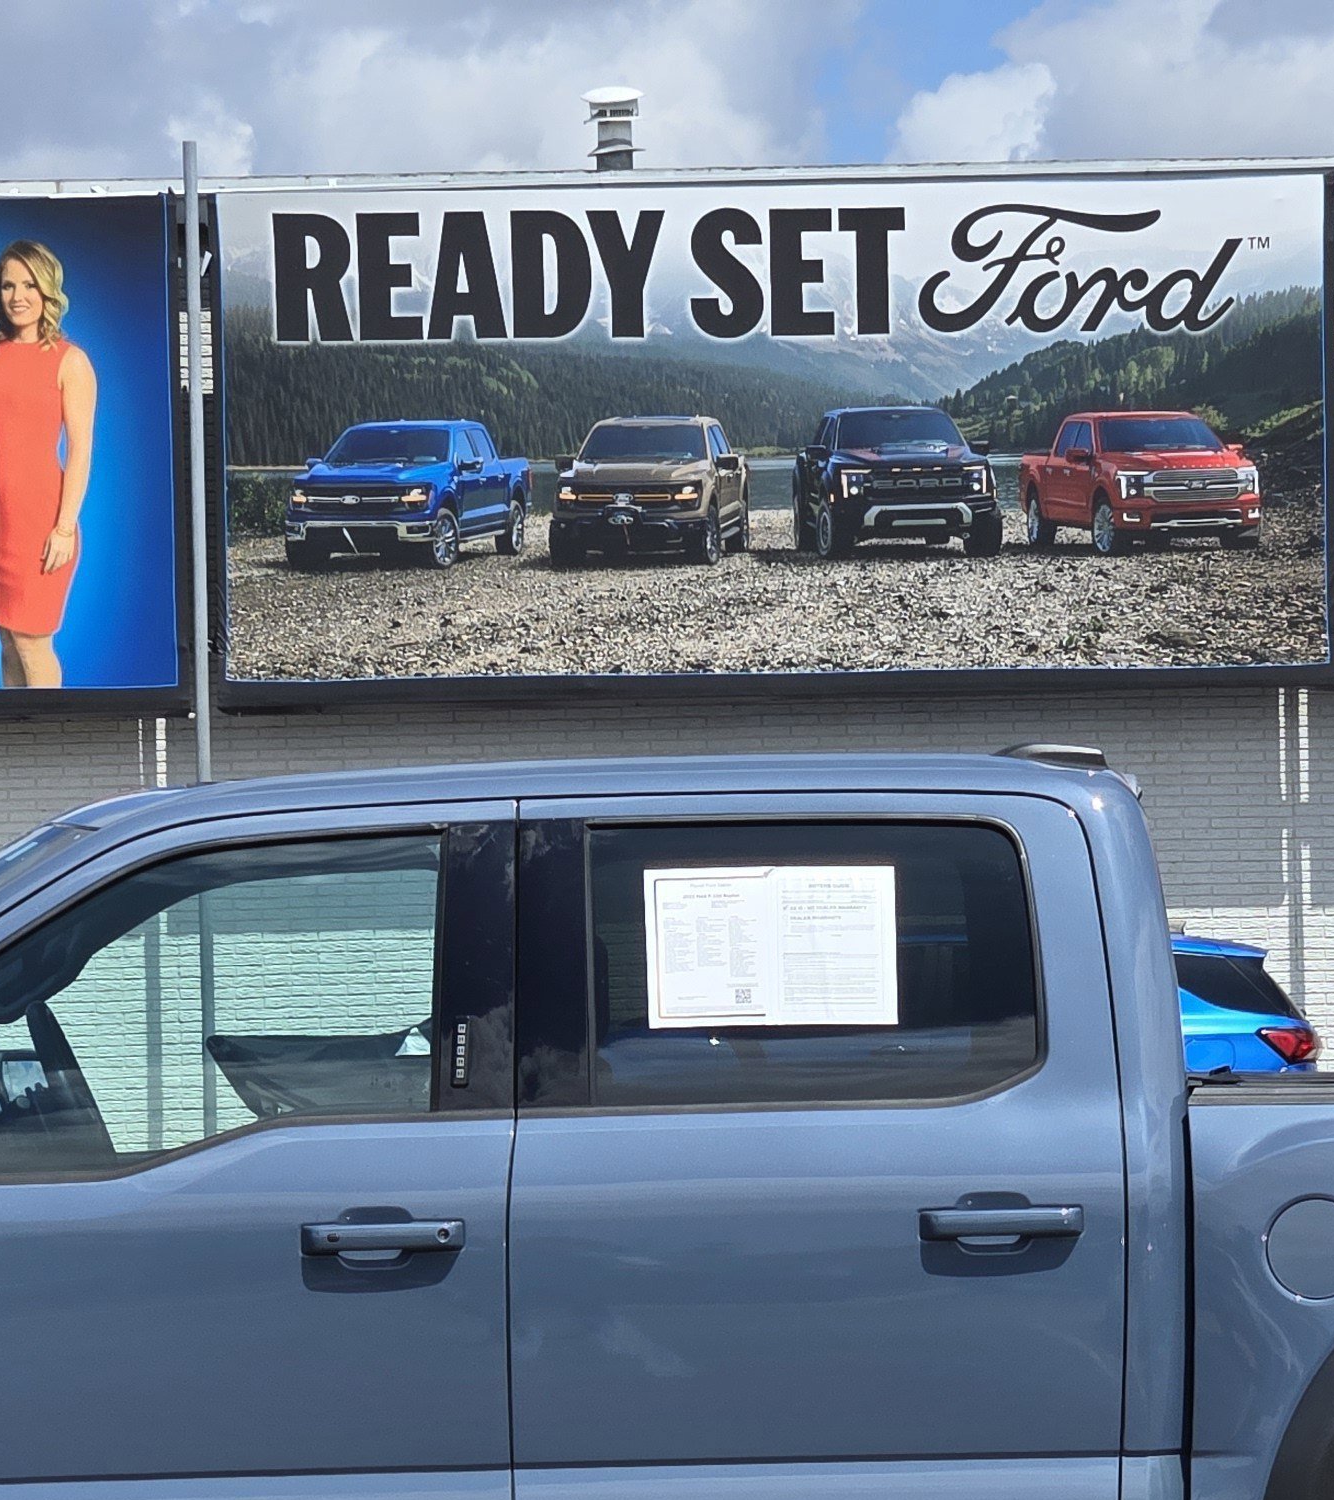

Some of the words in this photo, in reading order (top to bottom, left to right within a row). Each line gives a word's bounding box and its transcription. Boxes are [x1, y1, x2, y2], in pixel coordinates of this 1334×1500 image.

[272, 210, 665, 341] READY
[690, 207, 905, 338] SET
[918, 203, 1243, 332] Ford
[1247, 236, 1271, 250] TM
